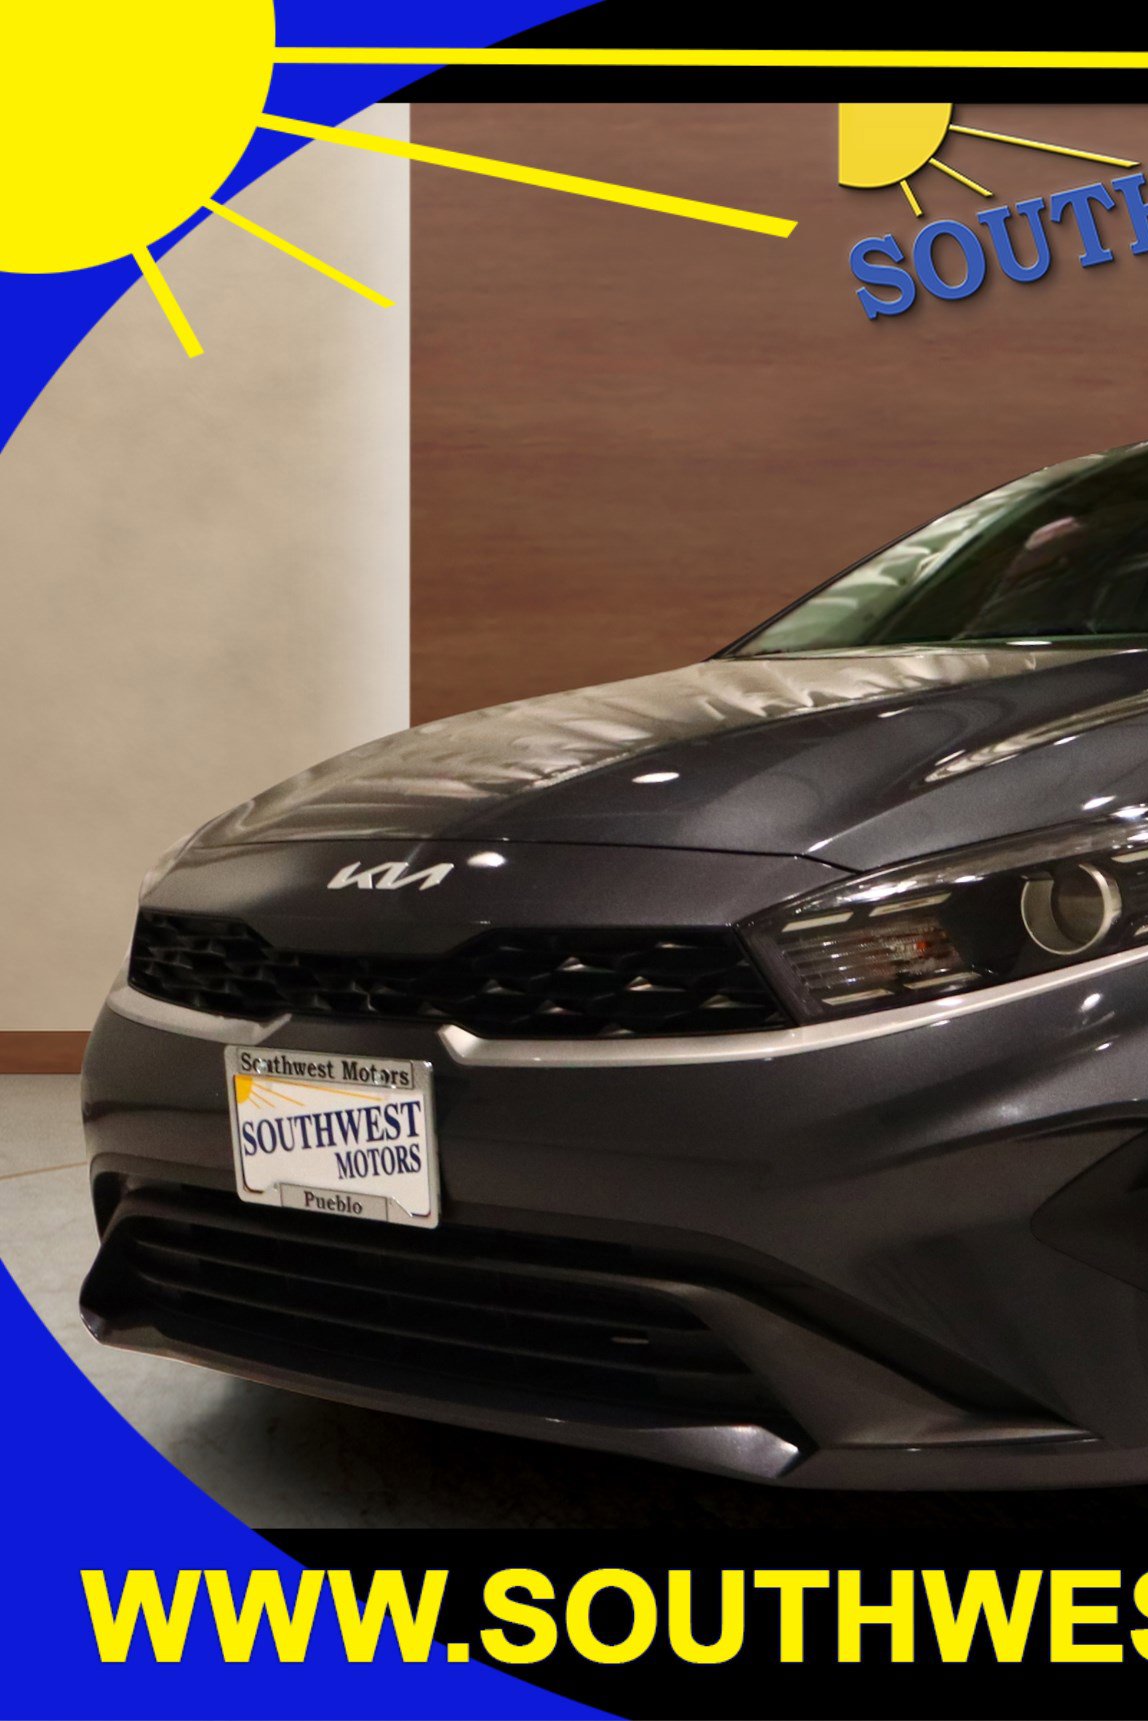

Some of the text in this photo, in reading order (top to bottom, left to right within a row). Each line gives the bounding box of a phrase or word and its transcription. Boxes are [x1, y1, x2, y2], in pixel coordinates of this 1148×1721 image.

[341, 1060, 410, 1086] Motors
[241, 1100, 422, 1157] SOUTHWEST
[334, 1143, 422, 1180] MOTORS
[303, 1191, 364, 1215] Pueblo
